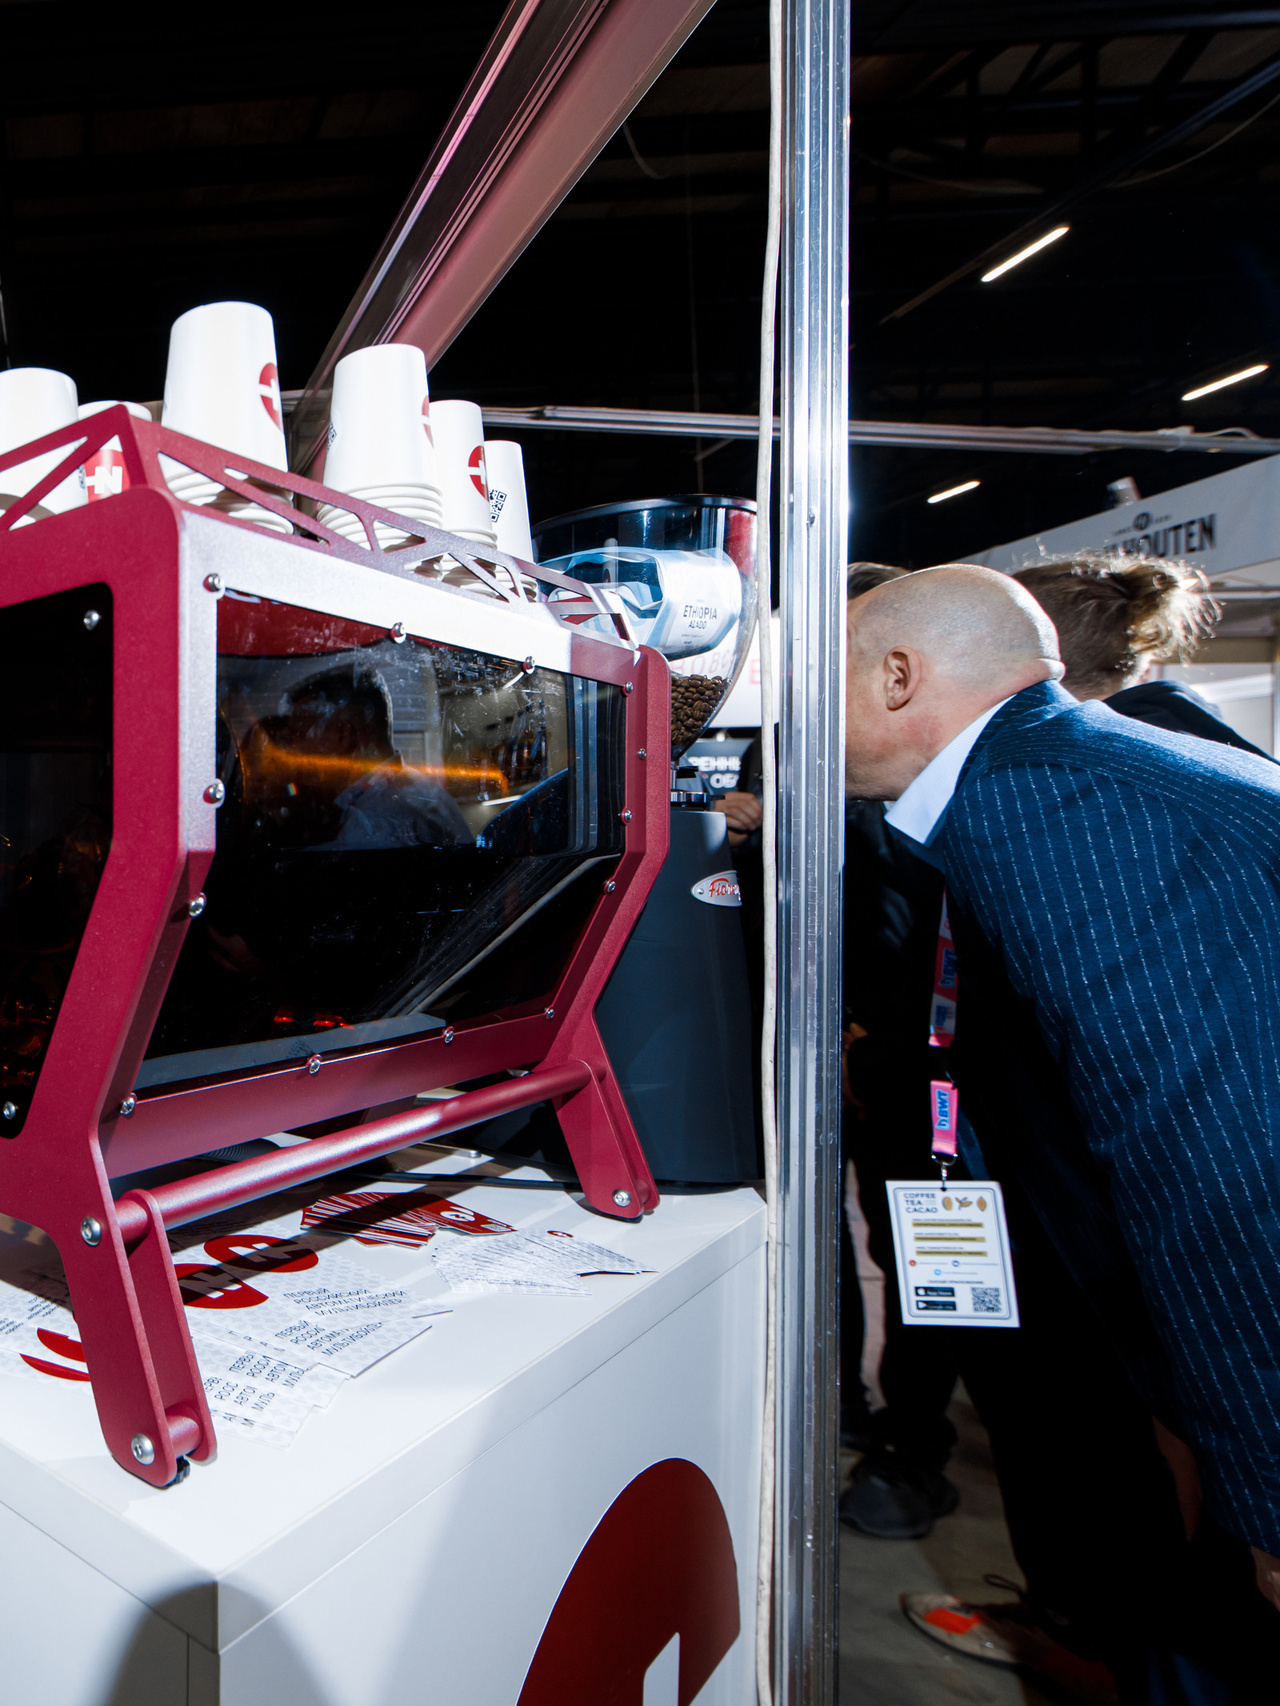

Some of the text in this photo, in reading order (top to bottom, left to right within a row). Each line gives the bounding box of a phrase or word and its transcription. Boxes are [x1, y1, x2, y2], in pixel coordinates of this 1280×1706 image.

[683, 604, 718, 620] ETHIOPIA
[937, 1089, 950, 1119] BWT
[905, 1206, 938, 1214] CACAO
[283, 1287, 331, 1299] ПЕРВЫЙ
[293, 1288, 371, 1305] РОССИЙСКИЙ
[305, 1290, 408, 1311] АВТОМАТИЧЕСКИЙ
